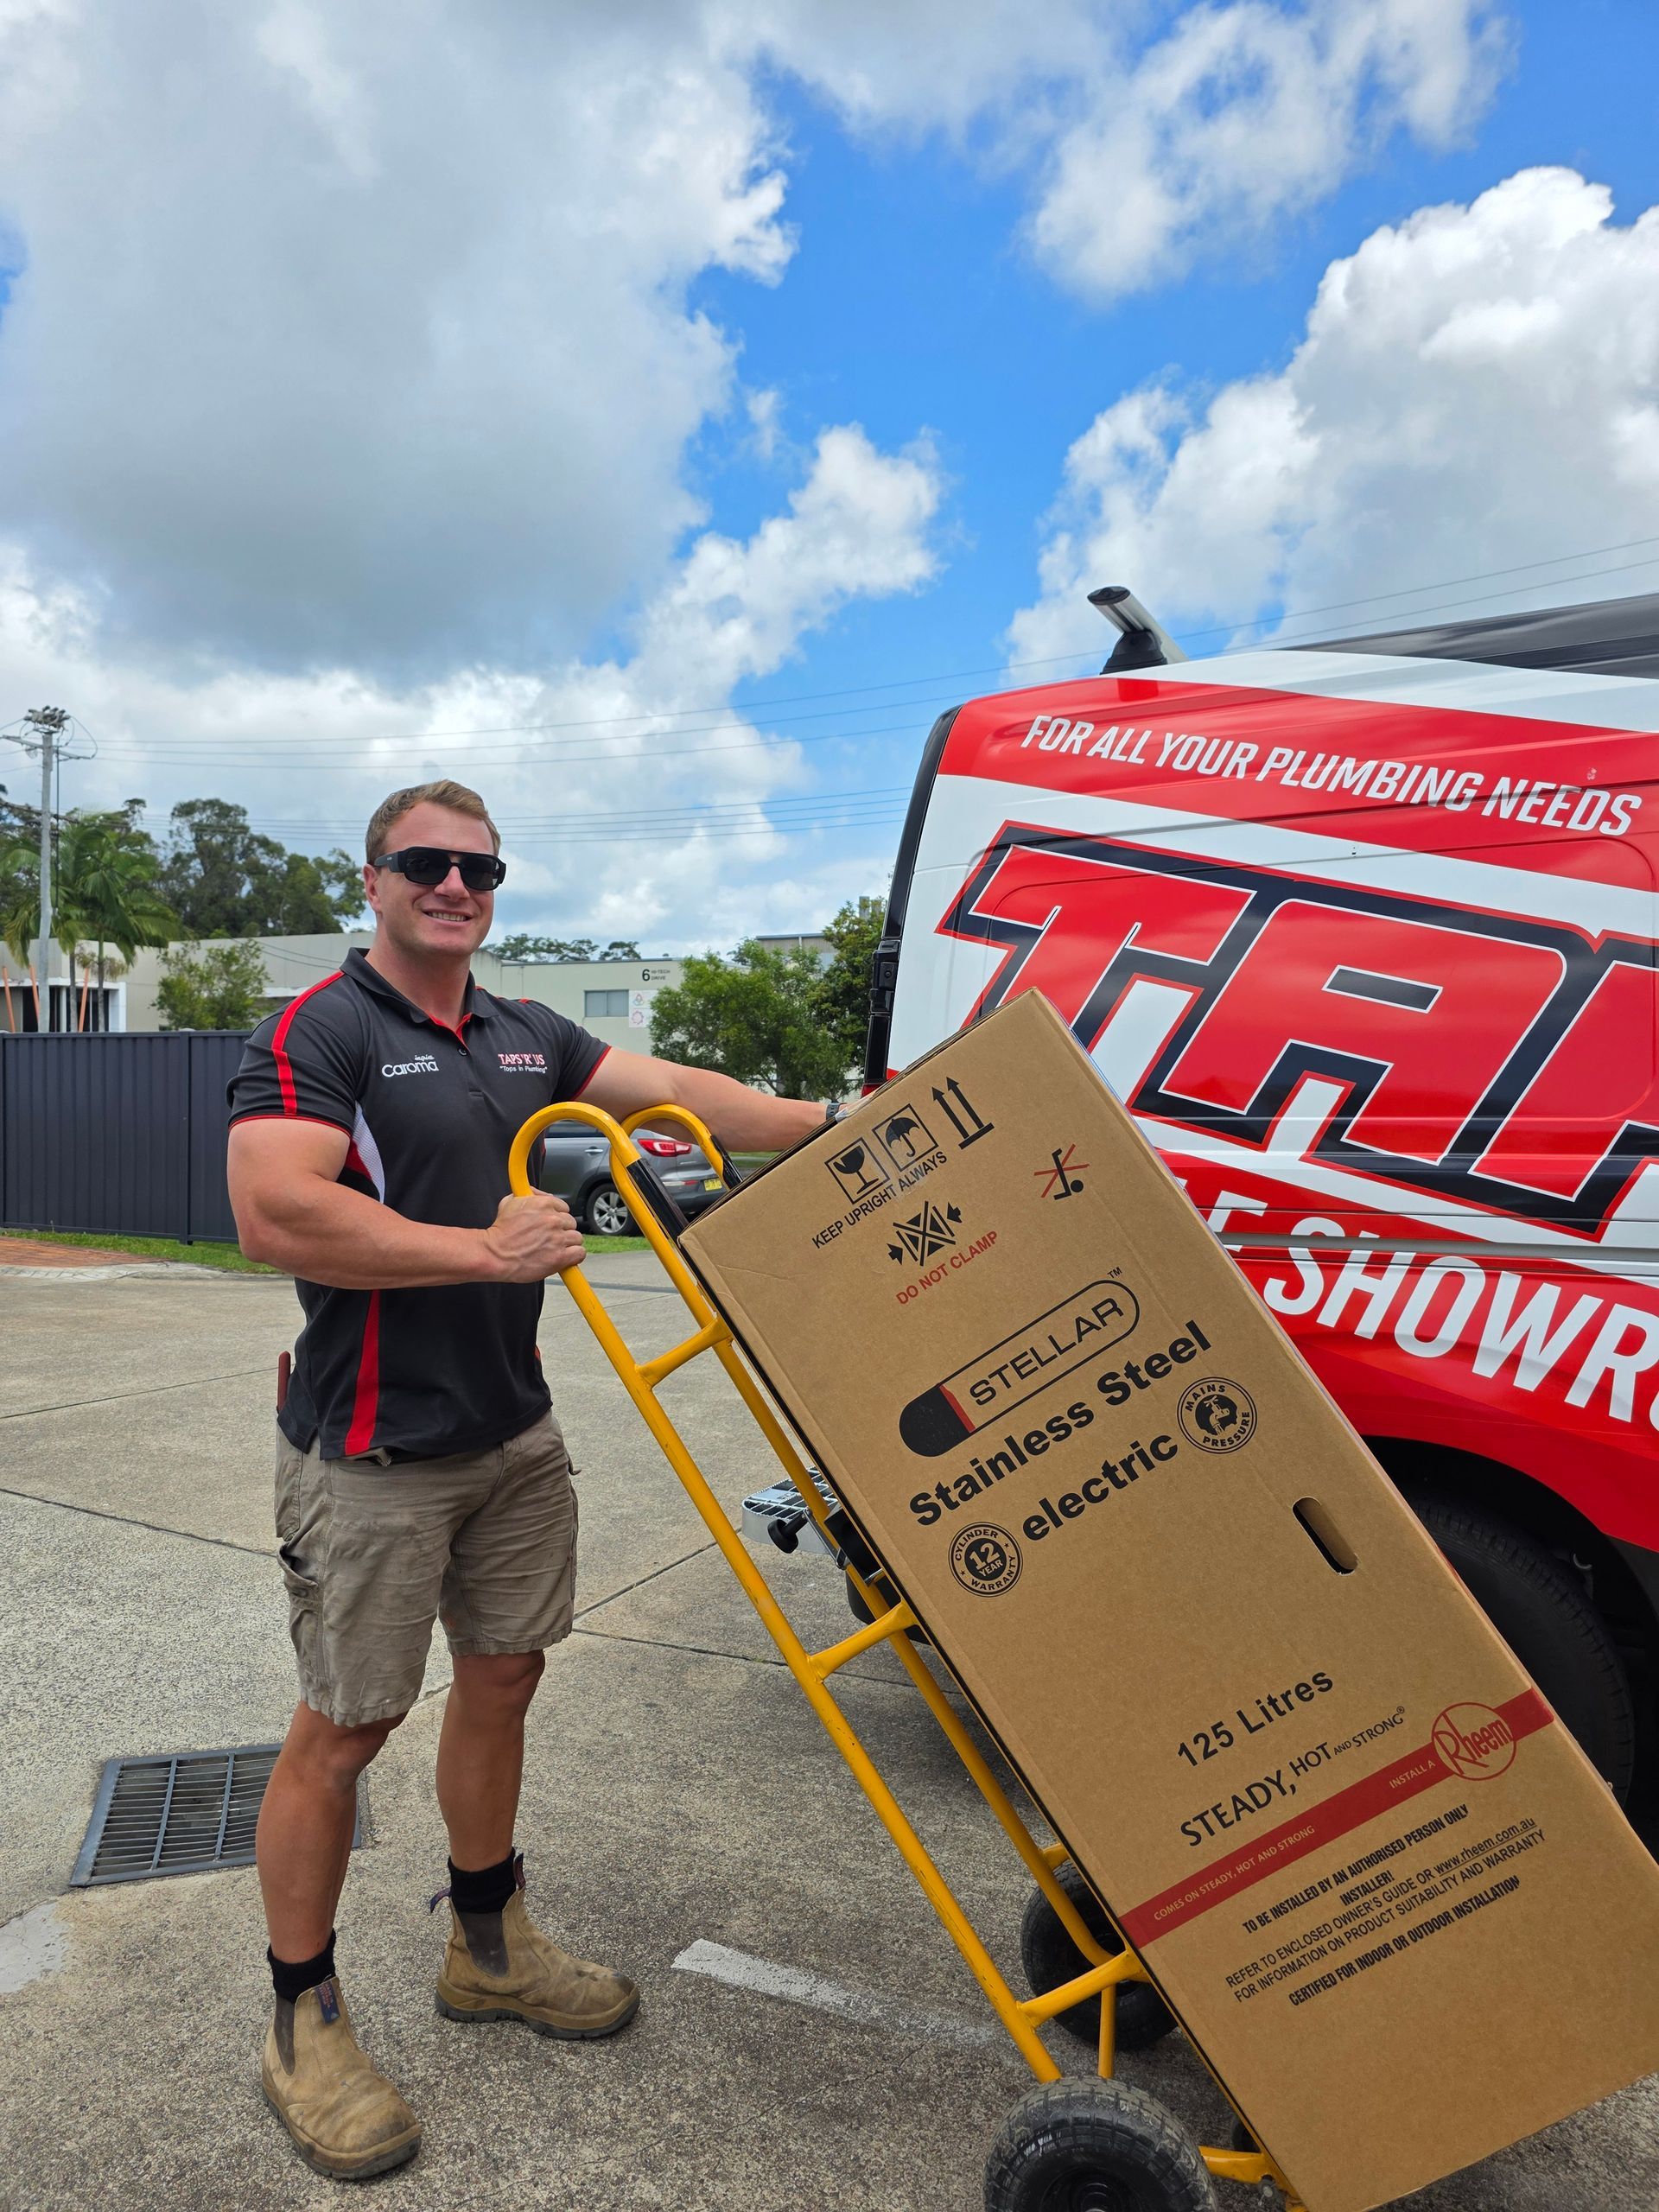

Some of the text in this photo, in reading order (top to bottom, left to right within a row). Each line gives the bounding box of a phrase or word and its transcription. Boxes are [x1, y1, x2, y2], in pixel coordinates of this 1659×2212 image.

[1020, 715, 1643, 836] FOR ALL YOUR PLUMBING NEEDS
[642, 969, 651, 982] 6
[381, 1060, 440, 1077] Caroma
[498, 1053, 523, 1065] TAPS
[532, 1053, 545, 1065] US
[811, 1151, 948, 1249] KEEP UPRIGHT ALWAYS
[895, 1230, 997, 1305] DO NOT CLAMP
[969, 1297, 1124, 1406] STELLAR
[1263, 1217, 1659, 1432] SHOWR
[909, 1319, 1211, 1526] Stainless Steel
[1185, 1383, 1226, 1412] MAINS
[1202, 1411, 1250, 1447] PRESSURE
[1022, 1434, 1179, 1541] electric
[955, 1529, 999, 1561] CYLINDER
[969, 1542, 1001, 1570] 12
[970, 1554, 1016, 1591] WARRANTY
[979, 1559, 1003, 1577] YEAR
[1177, 1672, 1333, 1767] 125 Litres
[1388, 1709, 1512, 1789] INSTALL A Rheem
[1180, 1769, 1297, 1847] STEADY,
[1288, 1742, 1332, 1777] HOT
[1333, 1740, 1352, 1756] AND
[1153, 1824, 1316, 1922] COMES ON STEADY, HOT AND STRONG
[1224, 1817, 1538, 1988] REFER TO ENCLOSED OWNER'S GUIDE OR www.rheem.com.au
[1234, 1828, 1546, 2003] FOR INFORMATION ON PRODUCT SUITABILITY AND WARRANTY
[1242, 1803, 1469, 1934] TO BE INSTALLED BY AN AUTHORISED PERSON ONLY
[1339, 1869, 1395, 1907] INSTALLER!
[1288, 1874, 1520, 2006] CERTIFIED FOR INDOOR OR OUTDOOR INSTALLATION
